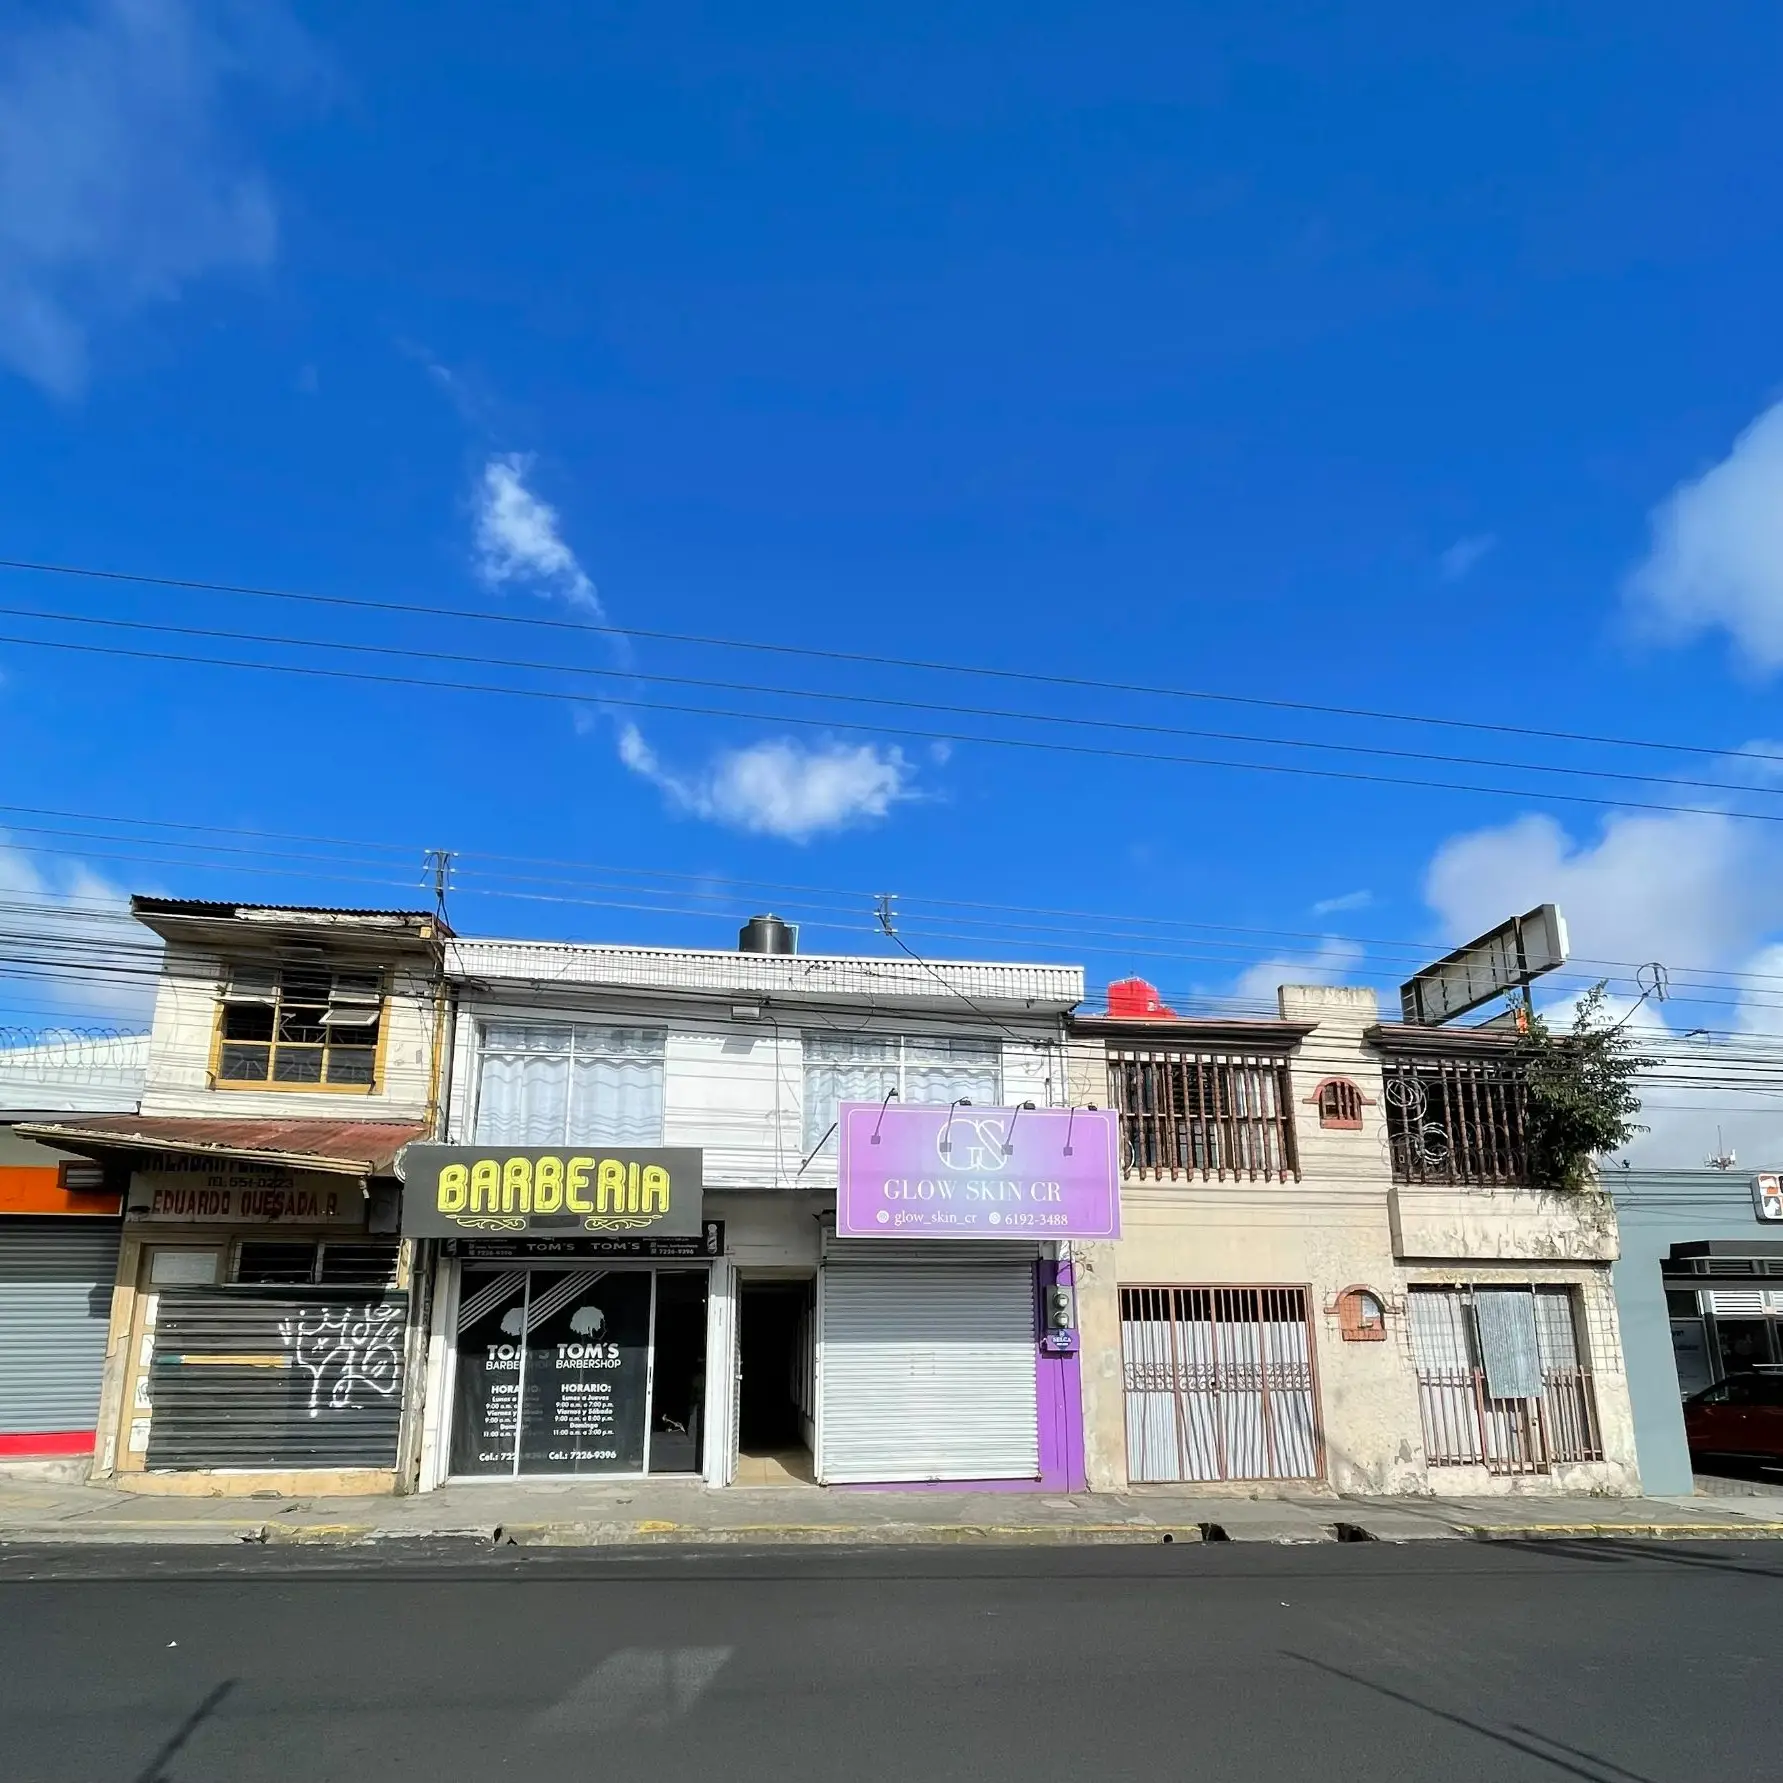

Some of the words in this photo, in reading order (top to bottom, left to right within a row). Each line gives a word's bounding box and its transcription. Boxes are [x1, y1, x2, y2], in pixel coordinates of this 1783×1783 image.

[437, 1156, 670, 1214] BARBERIA
[883, 1178, 957, 1200] GLOW
[966, 1180, 1022, 1201] SKIN
[1030, 1181, 1062, 1202] CR
[152, 1190, 231, 1215] EDUARDO
[240, 1190, 318, 1217] QUESADA
[894, 1210, 978, 1226] glow_skin_cr
[1005, 1213, 1068, 1226] 6192-3488
[526, 1243, 575, 1251] TOM'S
[590, 1242, 640, 1250] TOM'S
[557, 1342, 619, 1359] TOM'S
[555, 1359, 621, 1369] BARBERSHOP
[561, 1384, 611, 1393] HORARIO:
[569, 1422, 599, 1430] Domingo
[570, 1450, 617, 1460] 7226-9396
